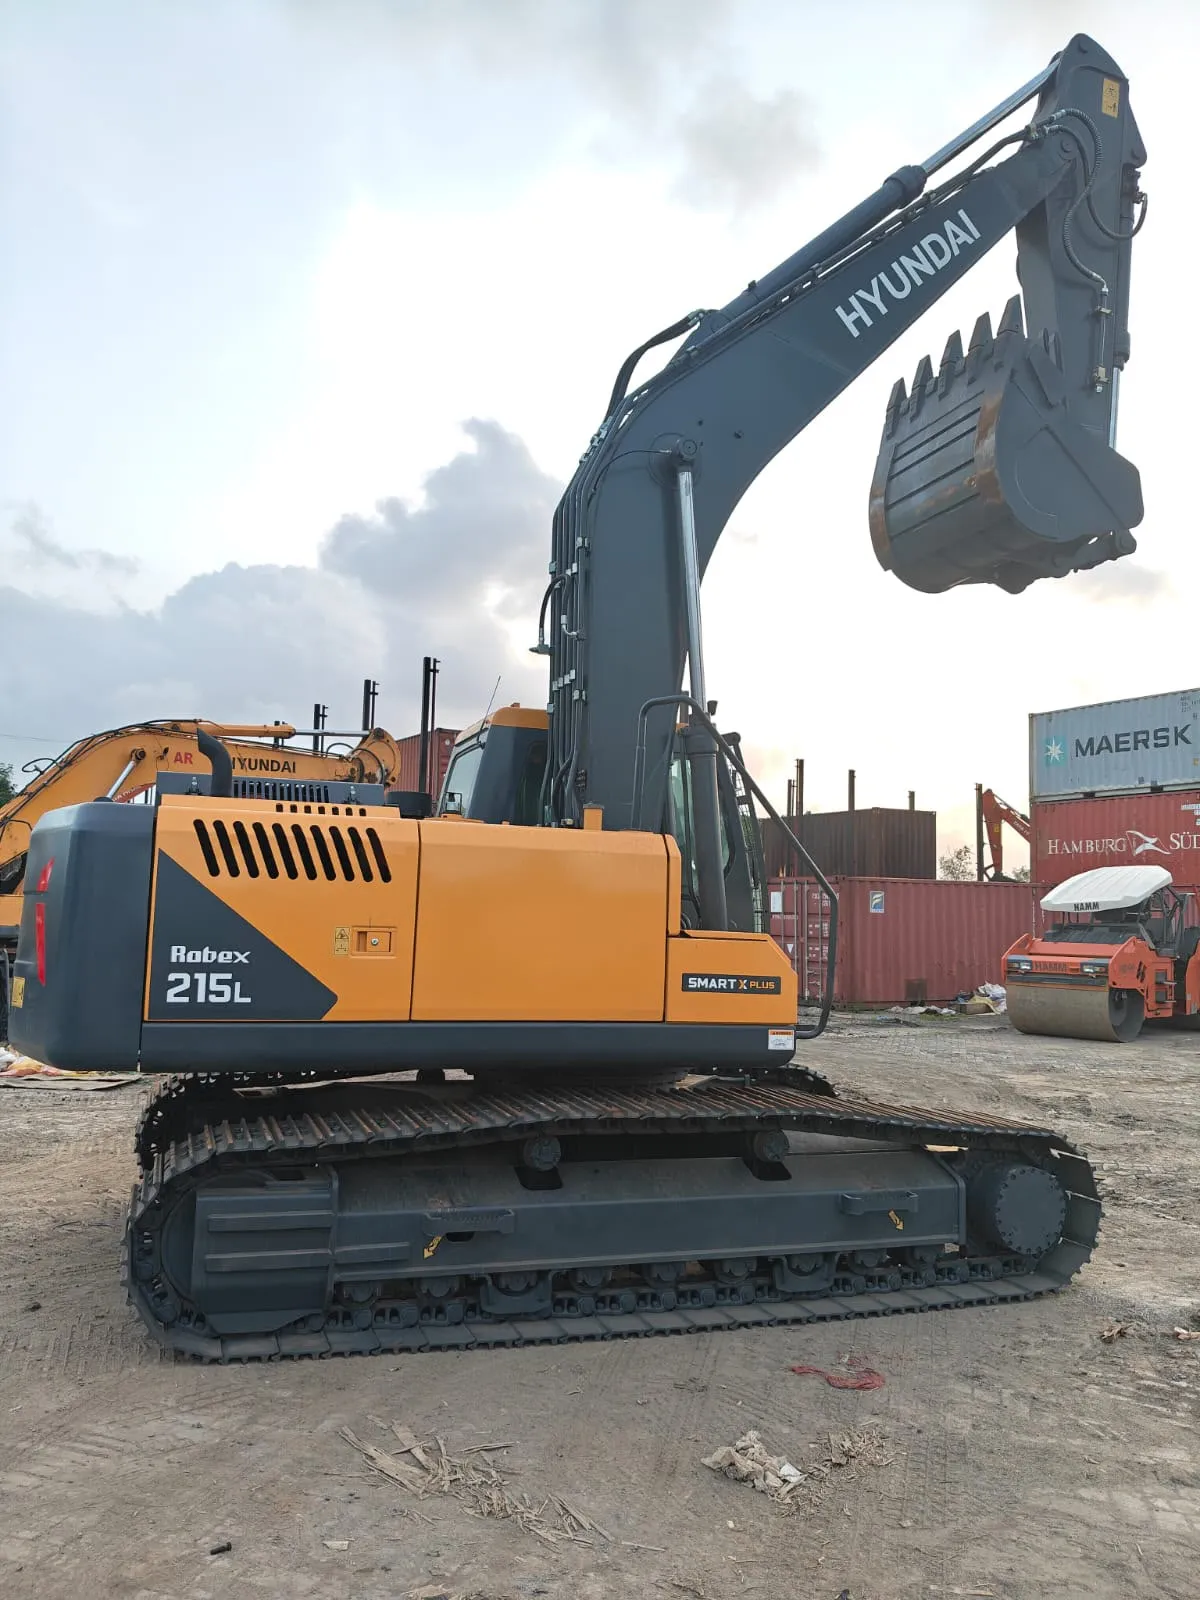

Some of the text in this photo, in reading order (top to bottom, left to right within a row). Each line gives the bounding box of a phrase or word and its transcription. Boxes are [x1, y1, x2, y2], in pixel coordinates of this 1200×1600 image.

[835, 208, 982, 338] HYUNDAI
[1075, 723, 1192, 758] MAERSK
[173, 751, 193, 765] AR
[1047, 837, 1127, 855] HAMBURG
[170, 945, 251, 964] Robex
[166, 972, 252, 1003] 215L
[688, 977, 737, 989] SMART
[749, 981, 775, 990] PLUS
